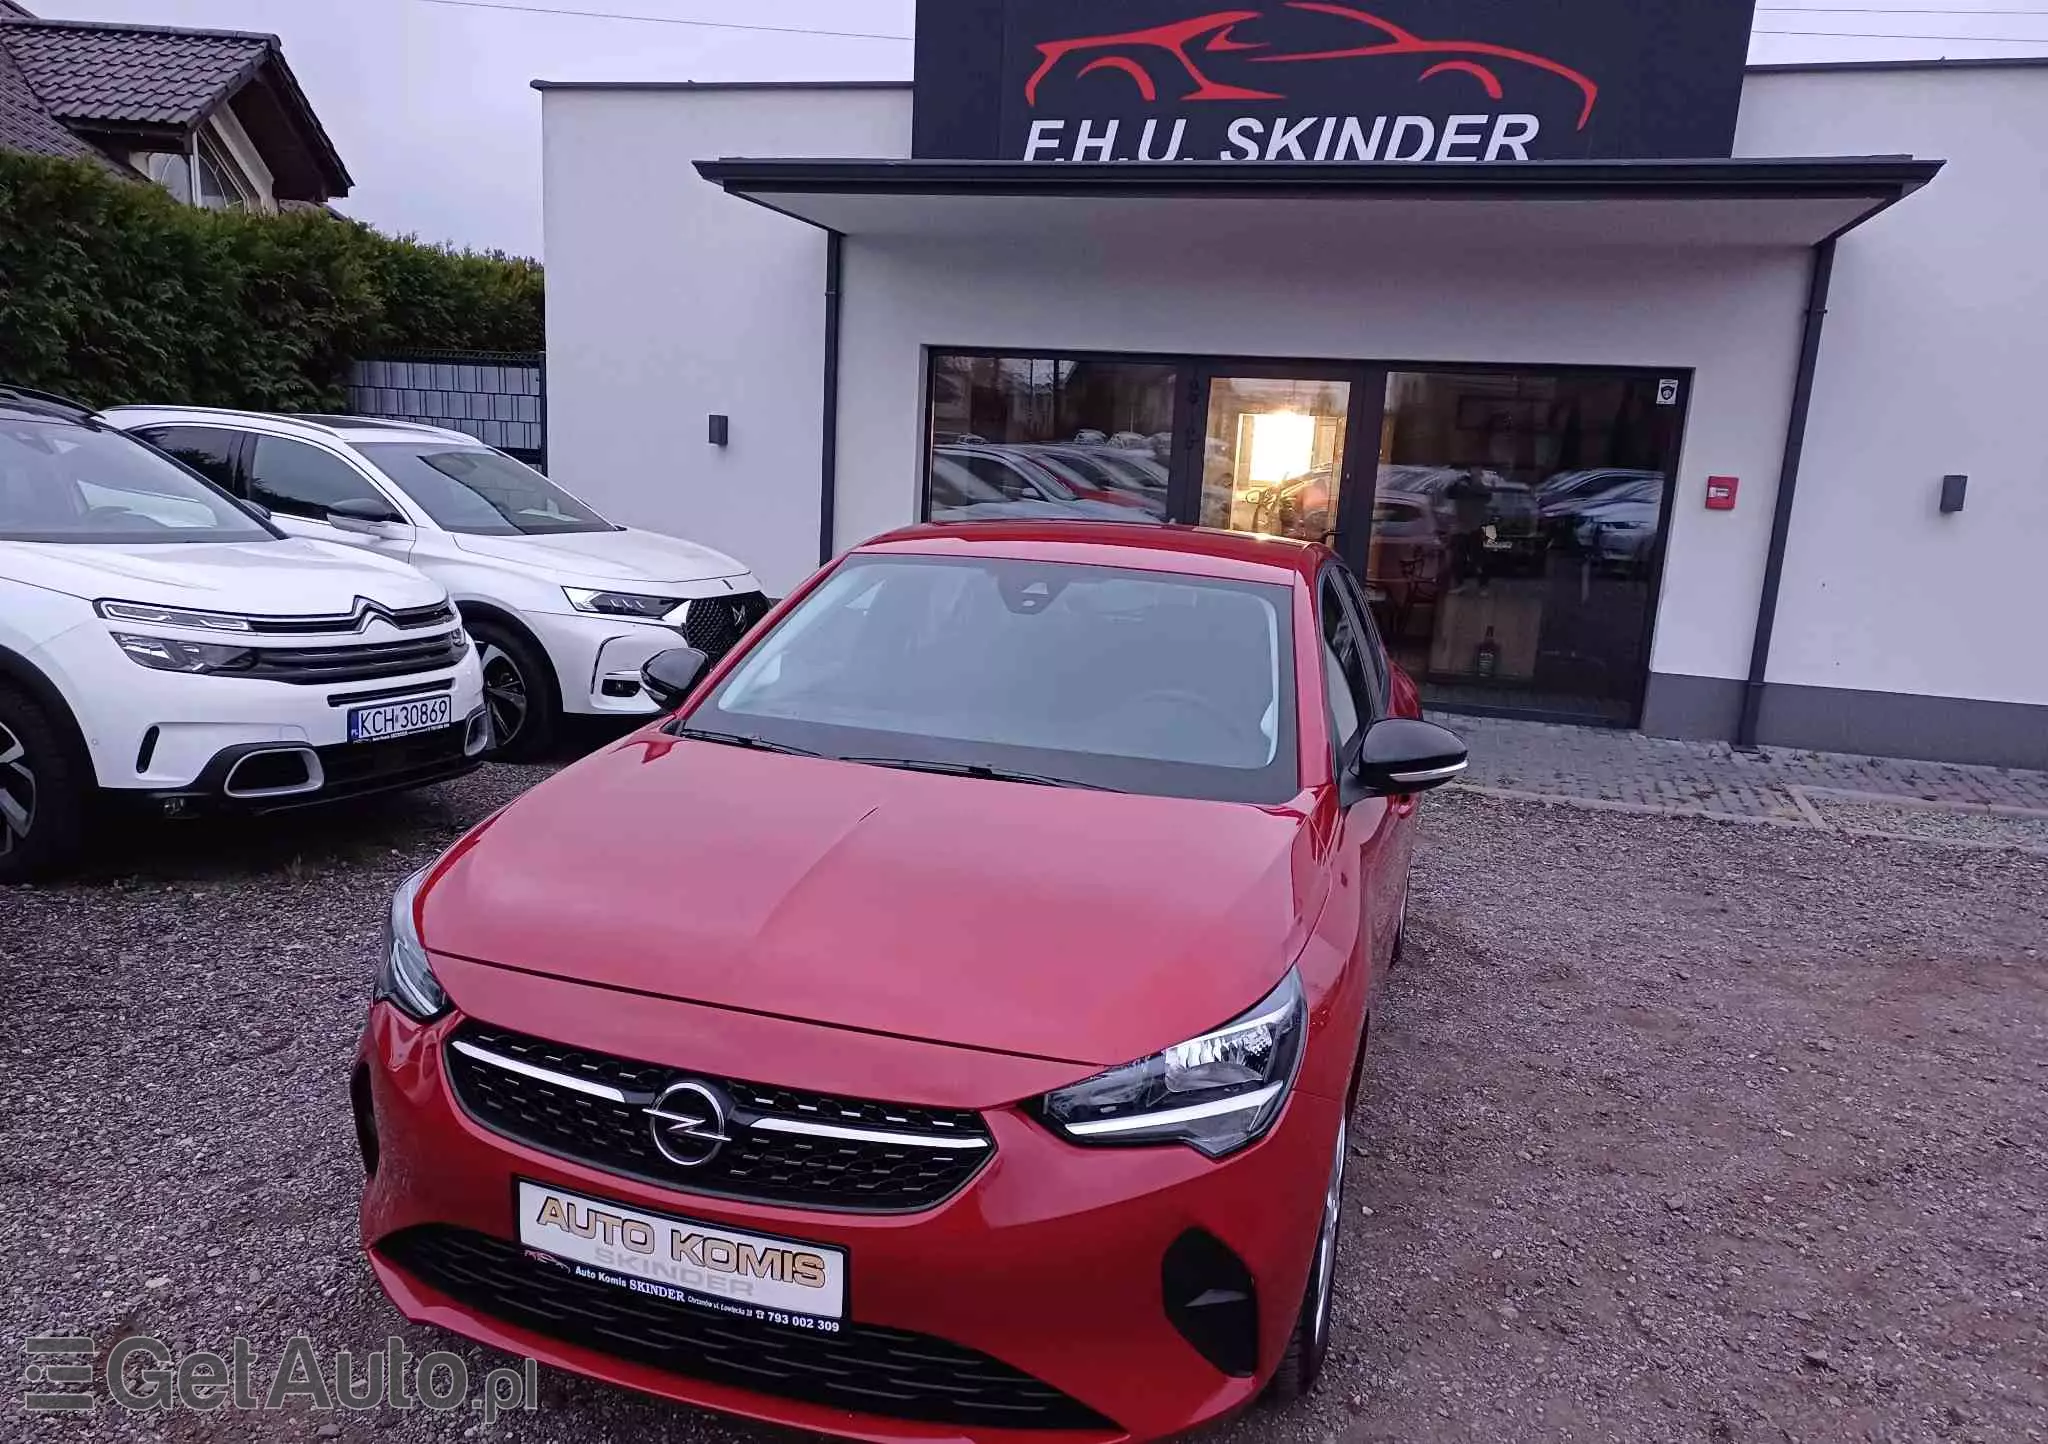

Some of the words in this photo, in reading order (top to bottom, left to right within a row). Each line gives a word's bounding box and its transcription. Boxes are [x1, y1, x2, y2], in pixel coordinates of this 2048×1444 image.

[1220, 114, 1539, 161] SKINDER
[360, 708, 394, 736] KCH
[400, 700, 448, 728] 30869
[536, 1196, 655, 1254] AUTO
[671, 1229, 825, 1288] KOMIS
[596, 1248, 754, 1296] SKINDER
[576, 1266, 596, 1279] Auto
[598, 1271, 627, 1287] Komis
[629, 1280, 685, 1303] SKINDER
[768, 1311, 789, 1324] 793
[792, 1316, 814, 1329] 002
[818, 1320, 840, 1332] 309
